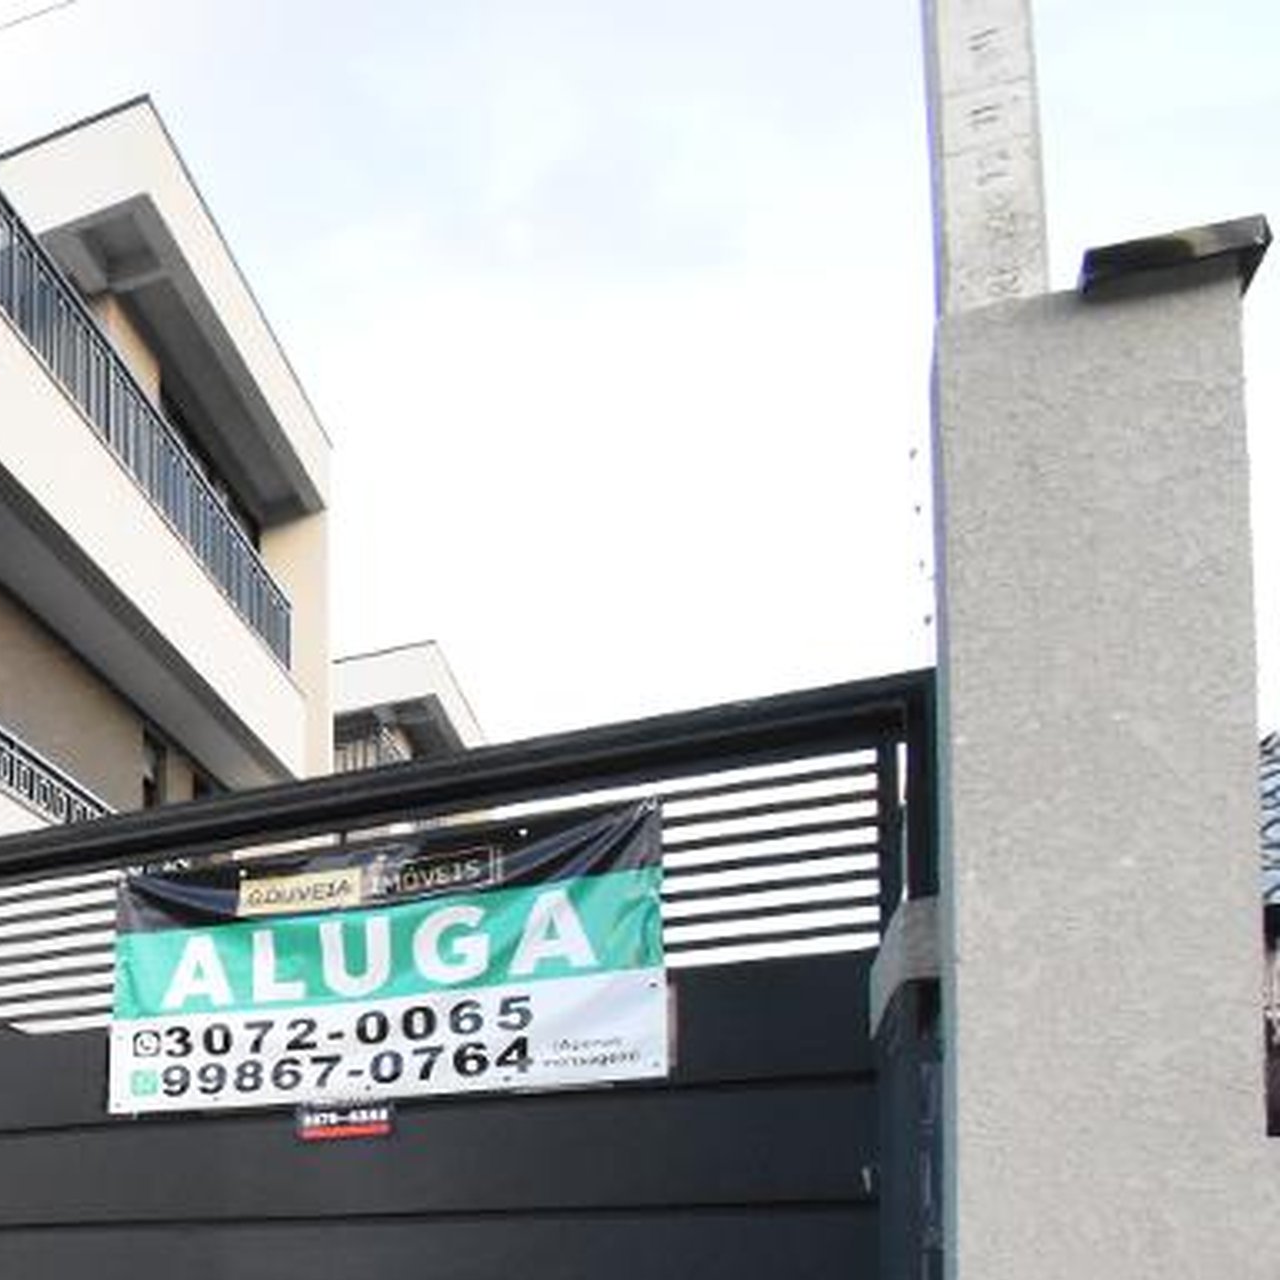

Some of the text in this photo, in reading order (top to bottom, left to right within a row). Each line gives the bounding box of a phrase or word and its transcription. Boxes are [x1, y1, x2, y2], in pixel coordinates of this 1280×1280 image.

[161, 890, 597, 1009] ALUGA
[165, 996, 534, 1058] 3072-0065
[161, 1037, 532, 1098] 99867-0764
